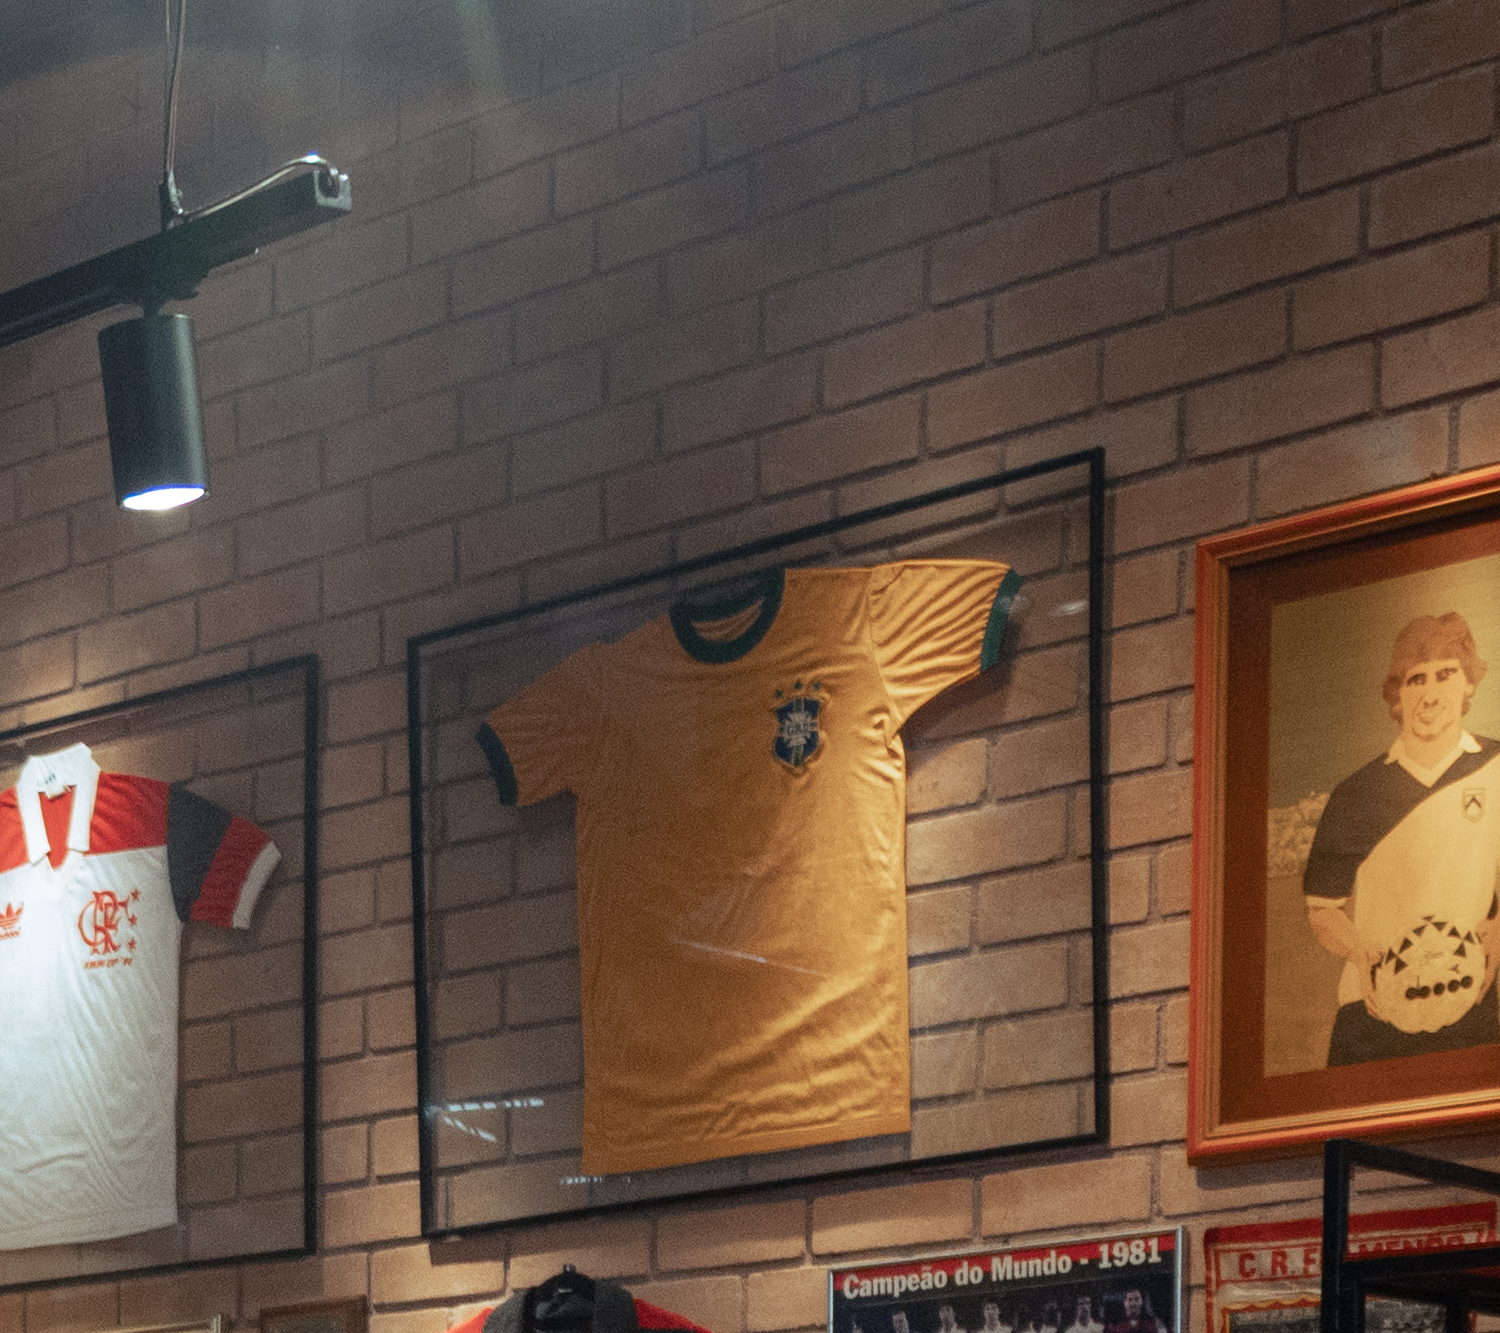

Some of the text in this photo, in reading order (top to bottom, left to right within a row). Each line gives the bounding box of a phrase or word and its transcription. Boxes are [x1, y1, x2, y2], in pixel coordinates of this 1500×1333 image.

[842, 1265, 948, 1299] Campeão
[955, 1260, 984, 1286] do
[992, 1251, 1072, 1282] Mundo
[1098, 1236, 1162, 1269] 1981
